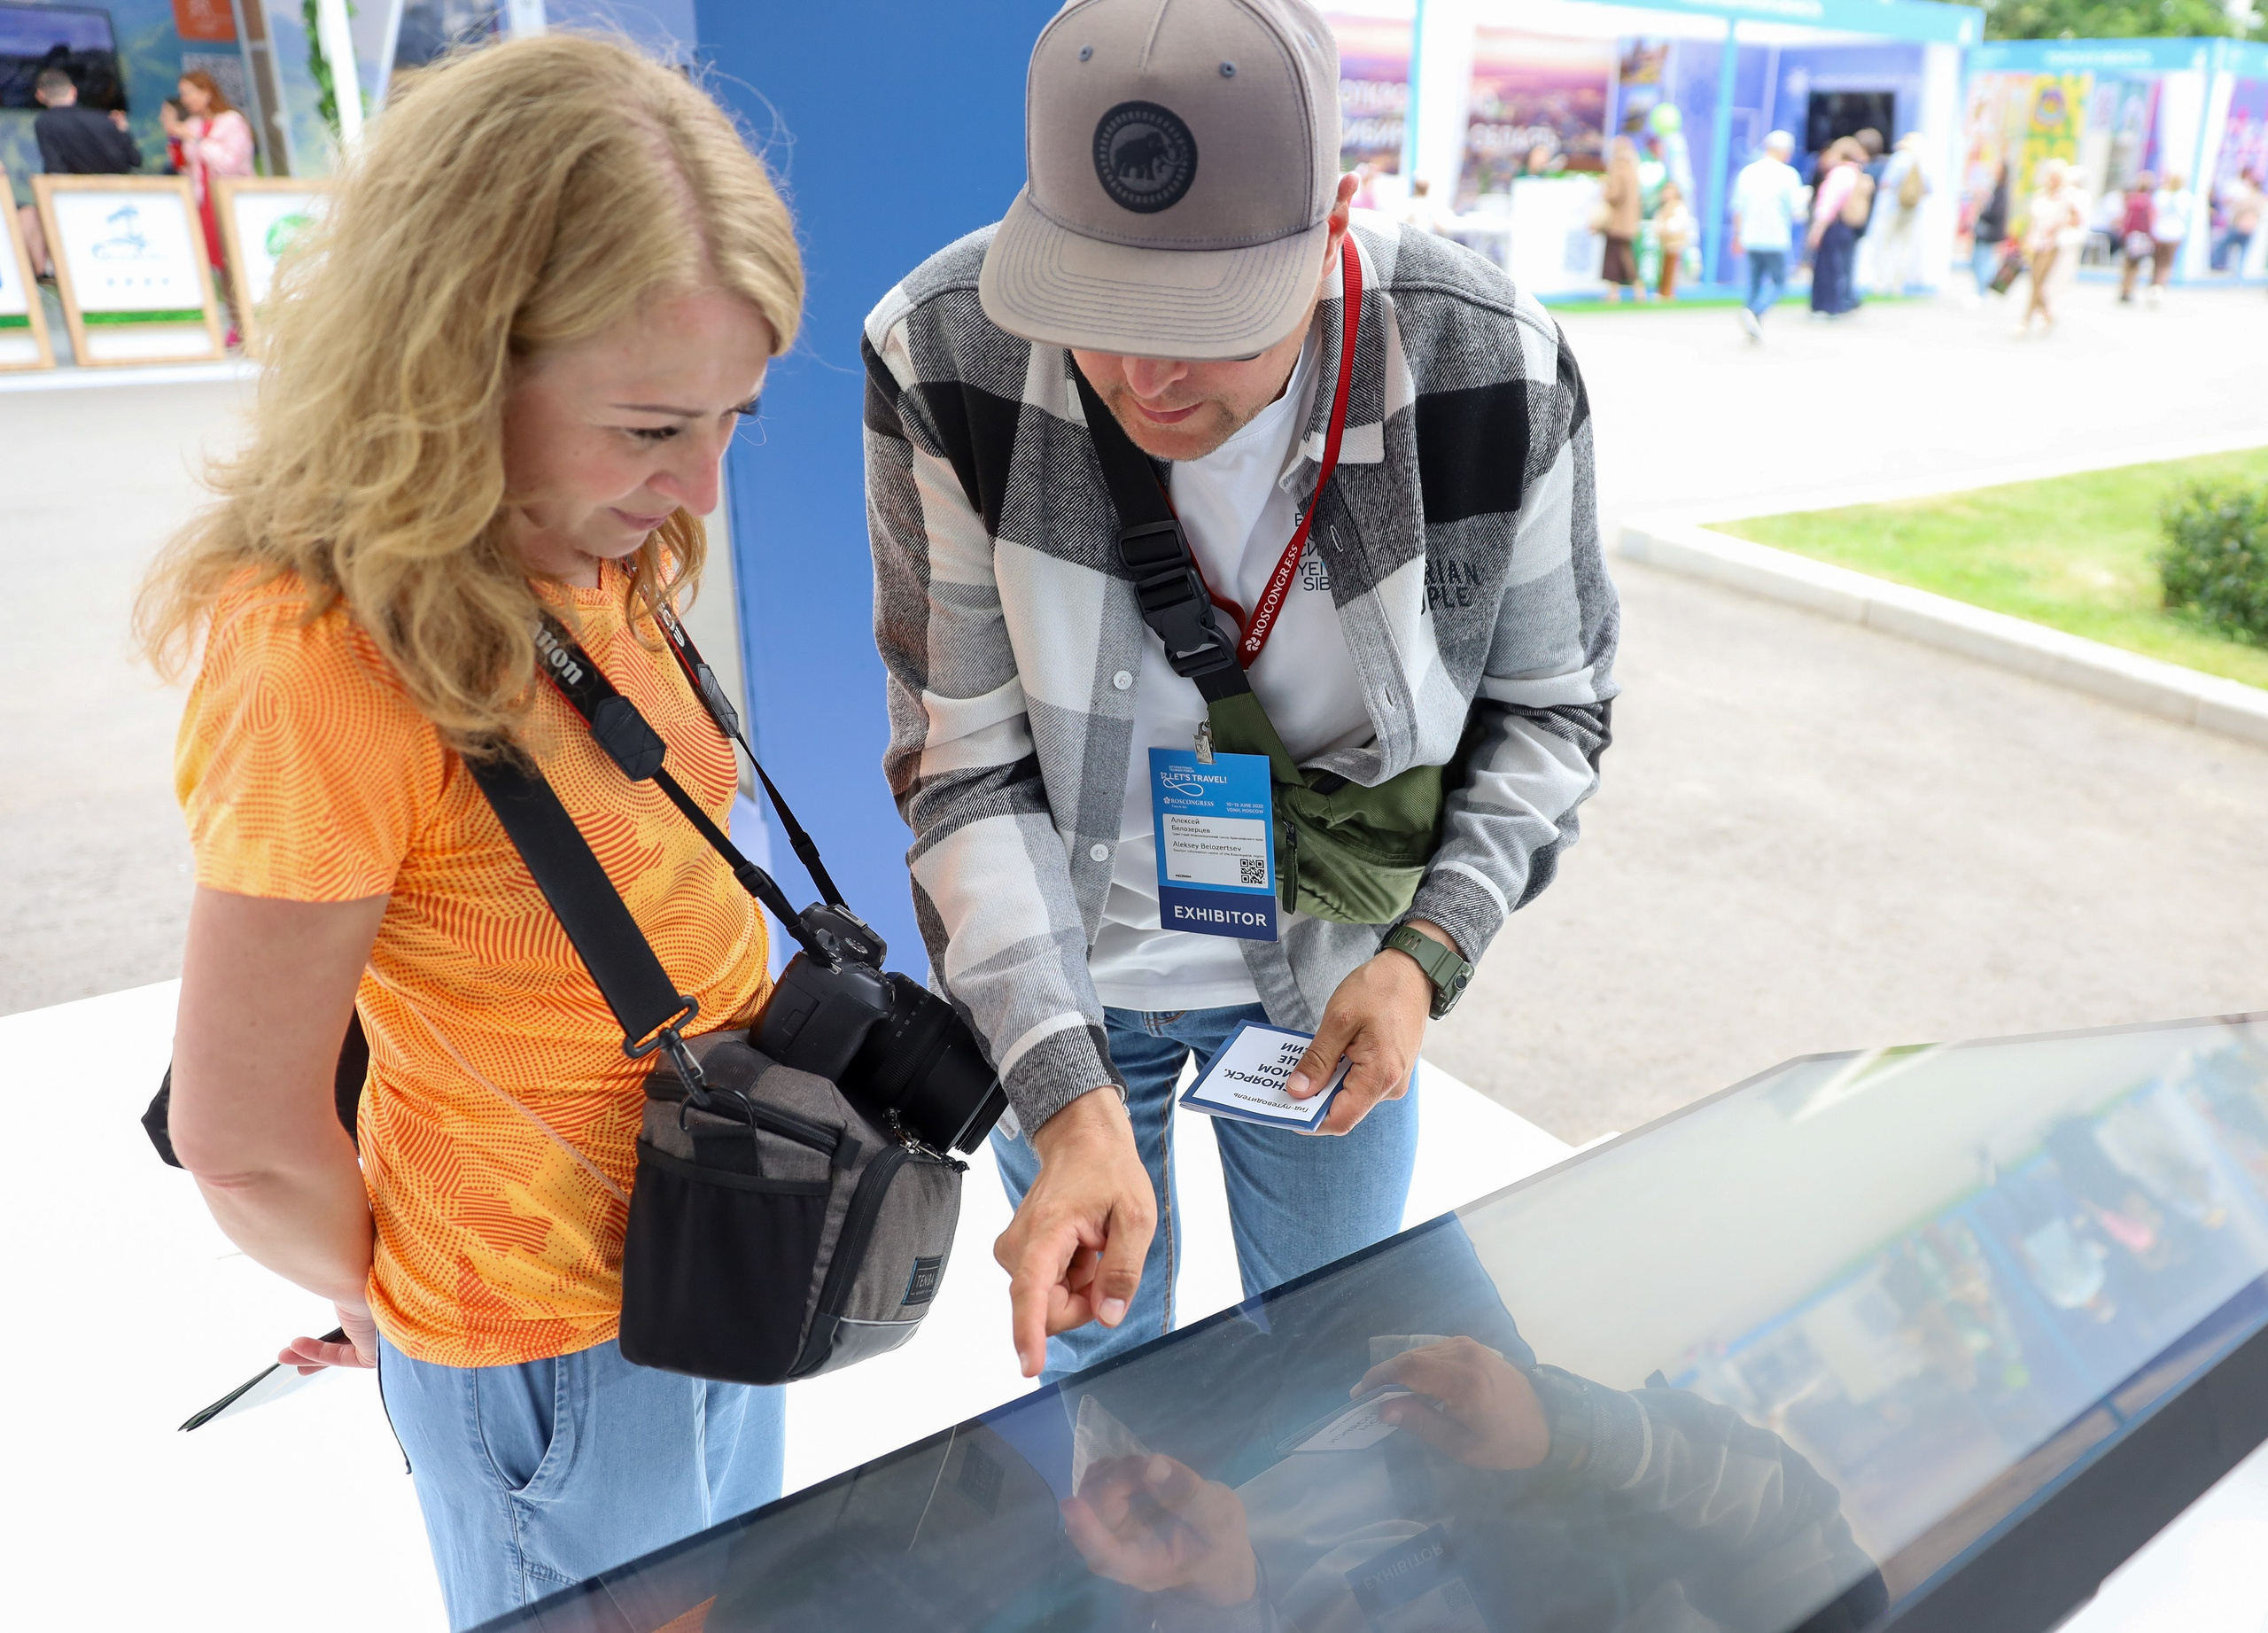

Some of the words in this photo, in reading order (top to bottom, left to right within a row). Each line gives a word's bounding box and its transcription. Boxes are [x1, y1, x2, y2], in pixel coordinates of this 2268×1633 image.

[1424, 559, 1480, 586] RIAN
[1252, 544, 1298, 637] ROSCONGRESS
[532, 622, 583, 685] non
[1192, 774, 1227, 783] TRAVEL!
[1171, 825, 1210, 834] Белозерцев
[1172, 841, 1200, 850] Aleksey
[1200, 843, 1241, 851] Belozertsev
[1174, 905, 1268, 927] EXHIBITOR
[1258, 1063, 1293, 1077] МОМ
[1223, 1069, 1287, 1093] НОЯРСК.
[1233, 1092, 1309, 1113] Гид-путеводитель
